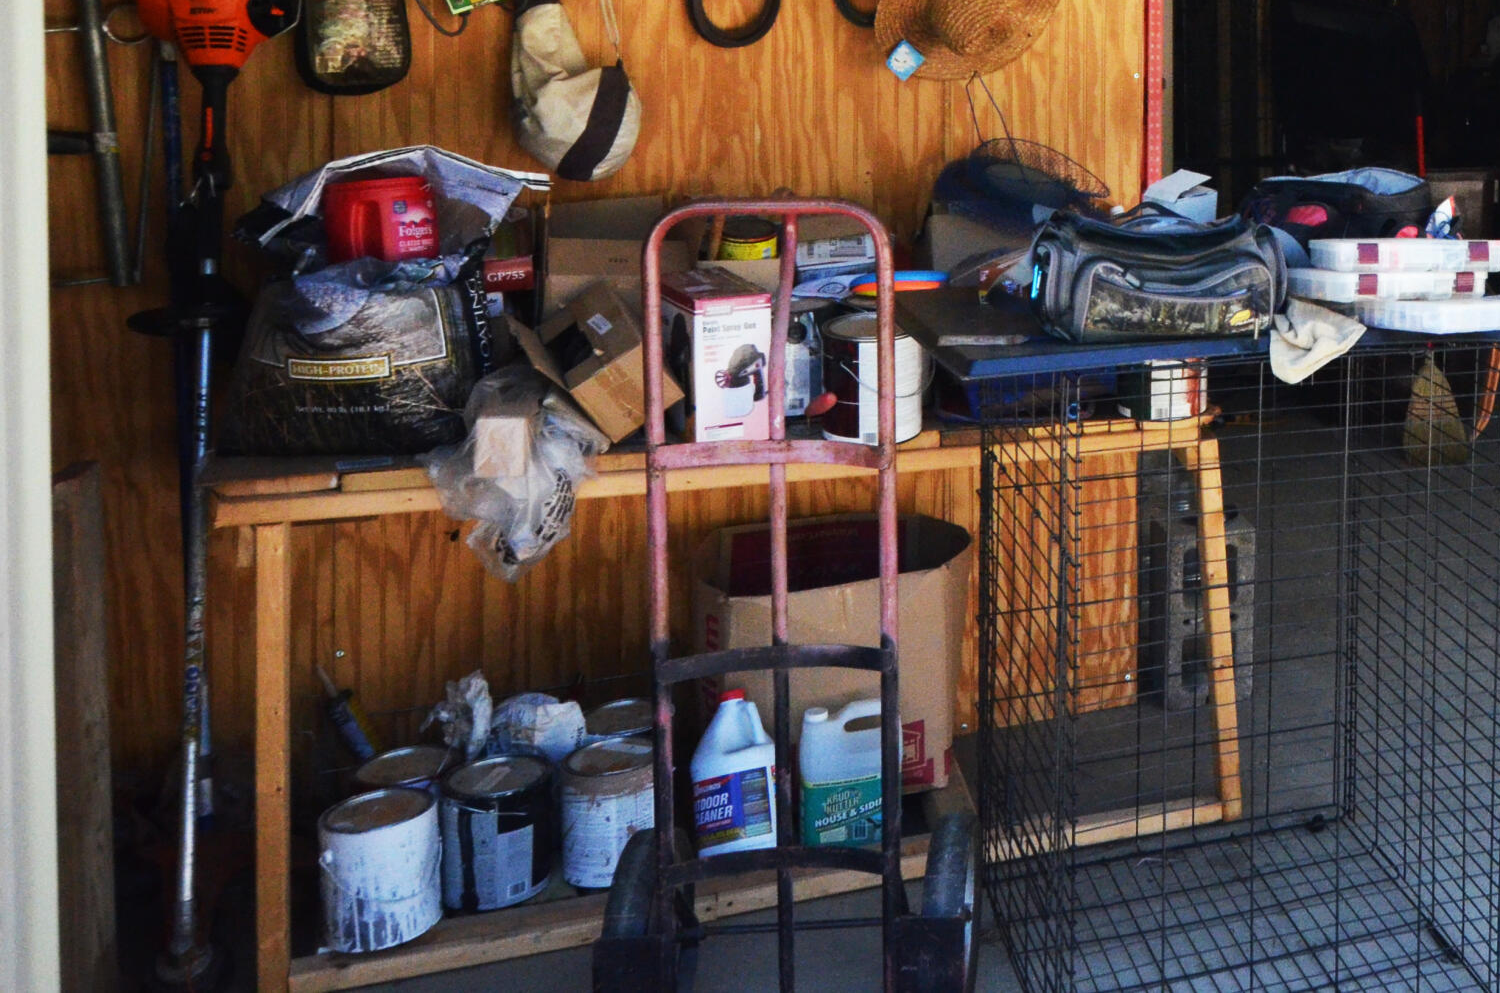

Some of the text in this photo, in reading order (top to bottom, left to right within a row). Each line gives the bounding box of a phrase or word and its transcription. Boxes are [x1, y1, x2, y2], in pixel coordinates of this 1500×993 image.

[486, 270, 526, 283] GP755
[814, 811, 848, 827] HOUSE
[859, 797, 882, 814] SIDI
